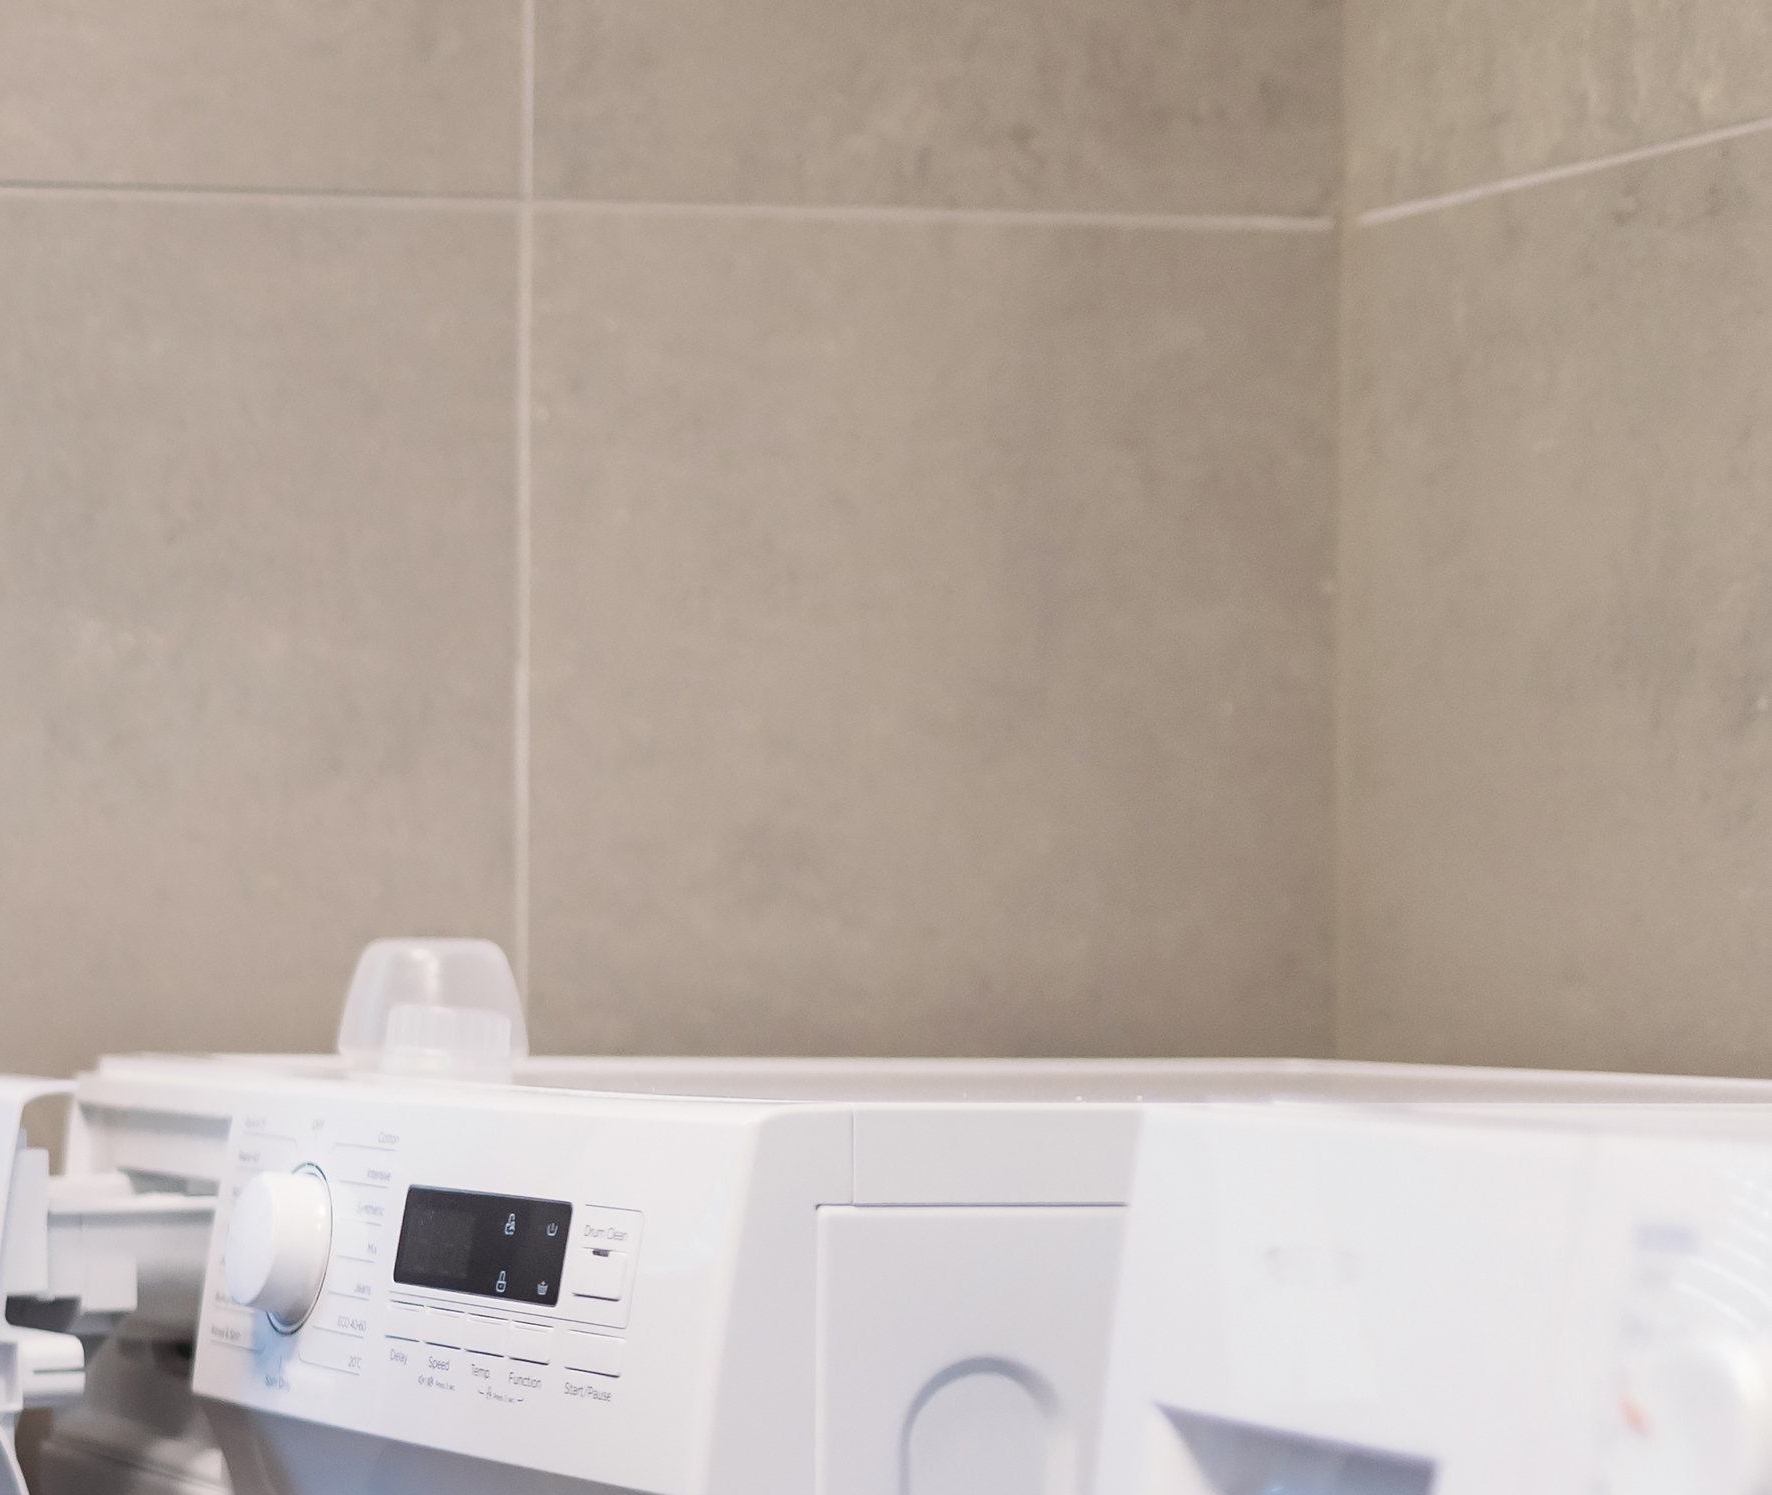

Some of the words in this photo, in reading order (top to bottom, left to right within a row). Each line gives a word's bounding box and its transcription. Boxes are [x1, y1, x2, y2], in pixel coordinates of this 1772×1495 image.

[377, 1131, 400, 1145] Cotton
[367, 1168, 392, 1182] Intensive
[357, 1201, 385, 1217] Synthetic
[583, 1224, 605, 1238] Drum
[606, 1227, 629, 1241] Clean
[367, 1242, 378, 1255] Mix
[354, 1283, 372, 1296] Jeans
[337, 1314, 350, 1329] ECO
[390, 1348, 407, 1366] Delay
[428, 1355, 450, 1372] Speed
[509, 1371, 542, 1390] Function
[564, 1381, 613, 1403] Start/Pause
